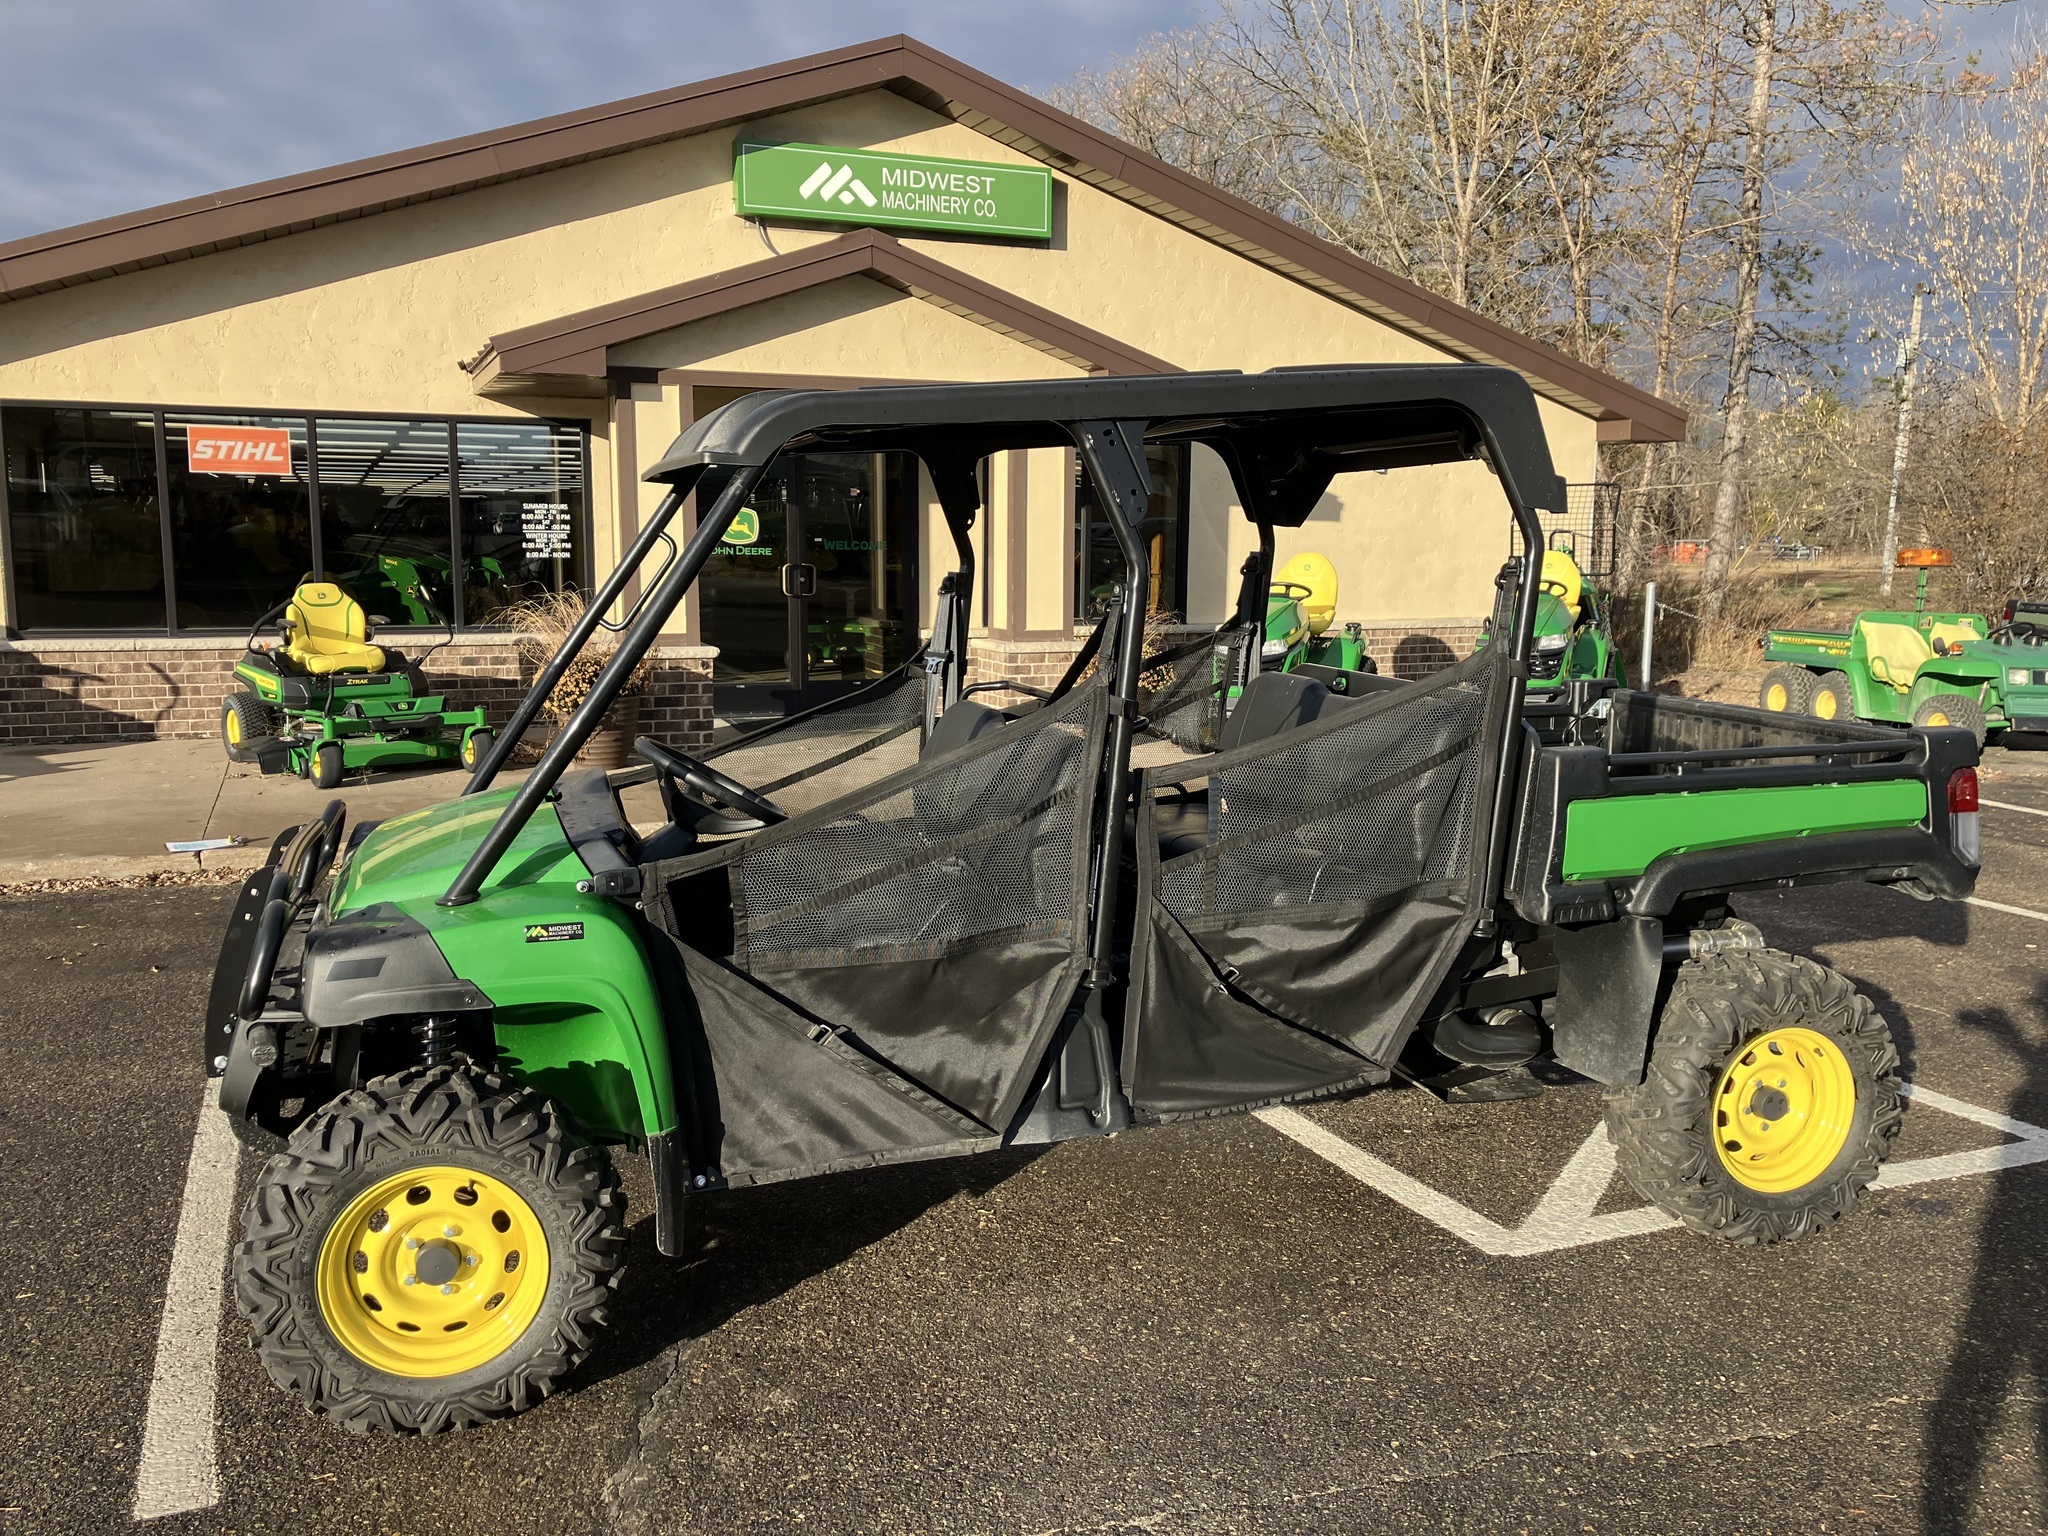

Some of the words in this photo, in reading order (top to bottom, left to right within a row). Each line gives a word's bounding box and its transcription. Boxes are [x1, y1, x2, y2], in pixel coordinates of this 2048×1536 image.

[882, 167, 996, 195] MIDWEST
[882, 190, 971, 215] MACHINERY
[974, 198, 998, 218] CO.
[192, 439, 284, 462] STIHL
[711, 546, 734, 555] OHN
[736, 546, 772, 556] DEERE
[823, 540, 888, 550] WELCOME
[409, 1148, 441, 1158] RADIAL
